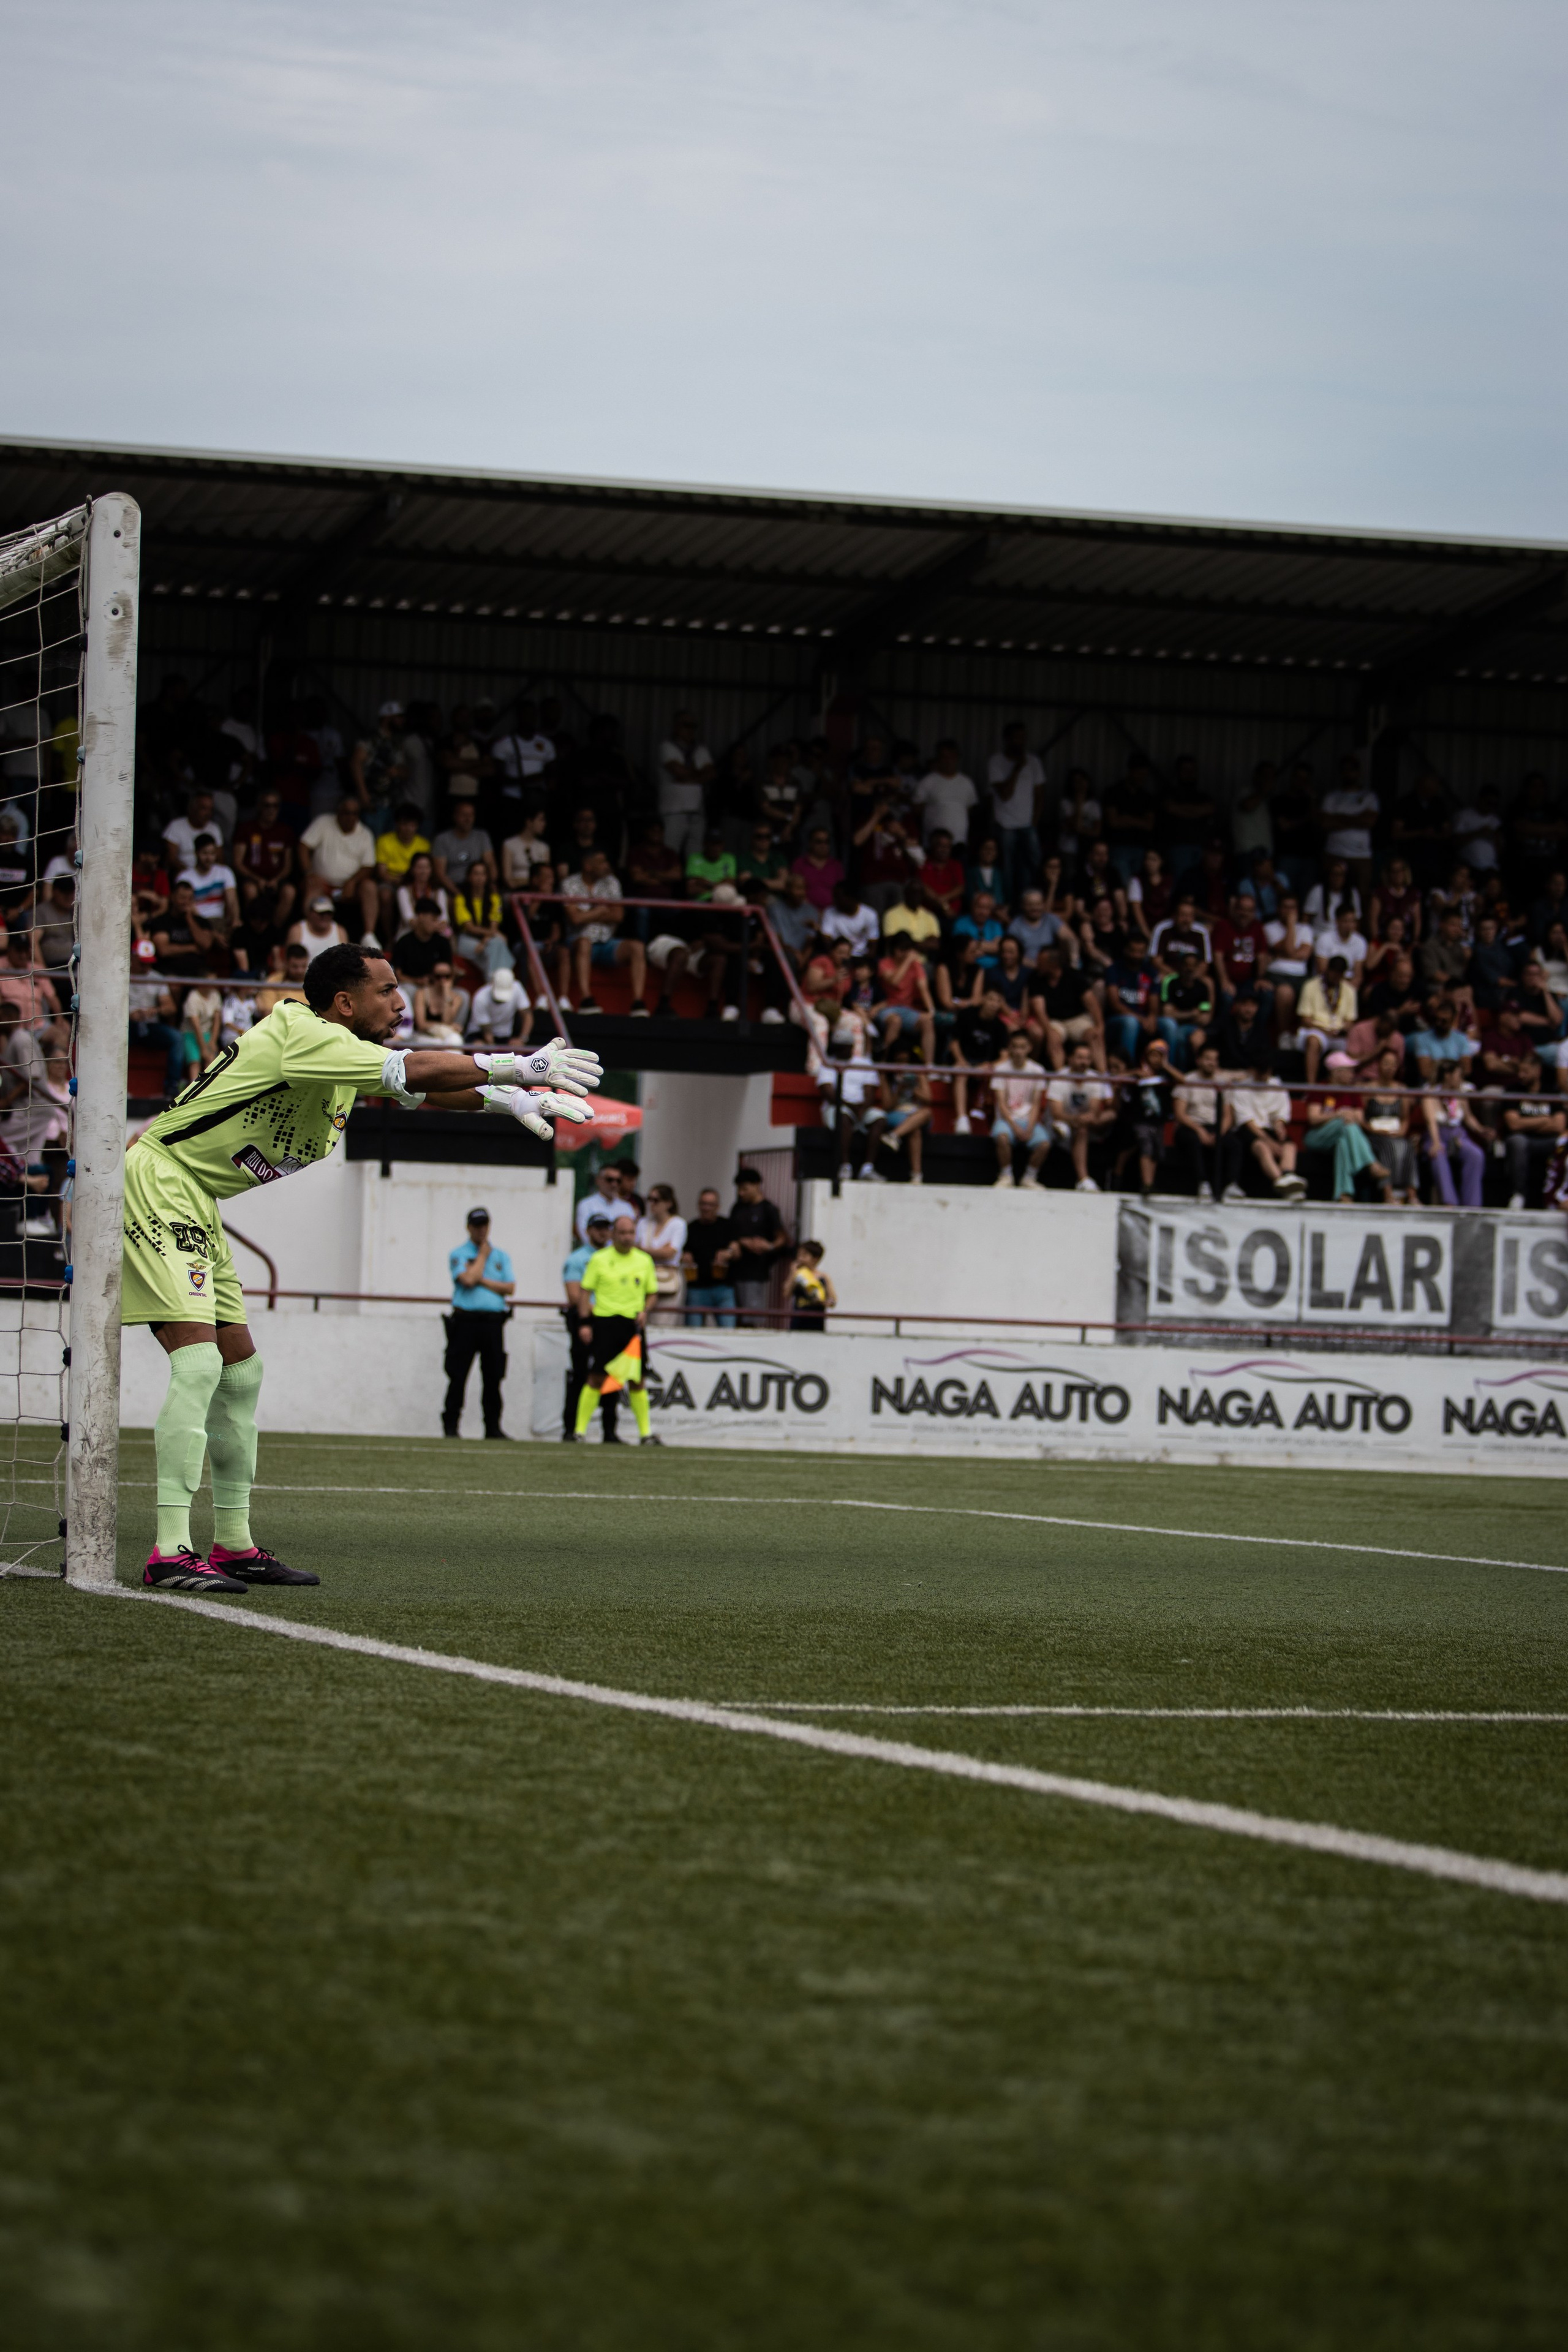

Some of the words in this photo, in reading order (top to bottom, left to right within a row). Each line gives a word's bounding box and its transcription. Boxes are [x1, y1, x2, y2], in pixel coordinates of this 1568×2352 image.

[245, 1151, 262, 1170] RUI
[257, 1164, 273, 1182] DO
[1157, 1225, 1445, 1313] ISOLAR
[706, 1371, 829, 1414] AUTO
[871, 1376, 1000, 1419] NAGA
[1009, 1381, 1131, 1423] AUTO
[1157, 1387, 1284, 1430] NAGA
[1292, 1392, 1412, 1434] AUTO
[1443, 1396, 1567, 1438] NAGA
